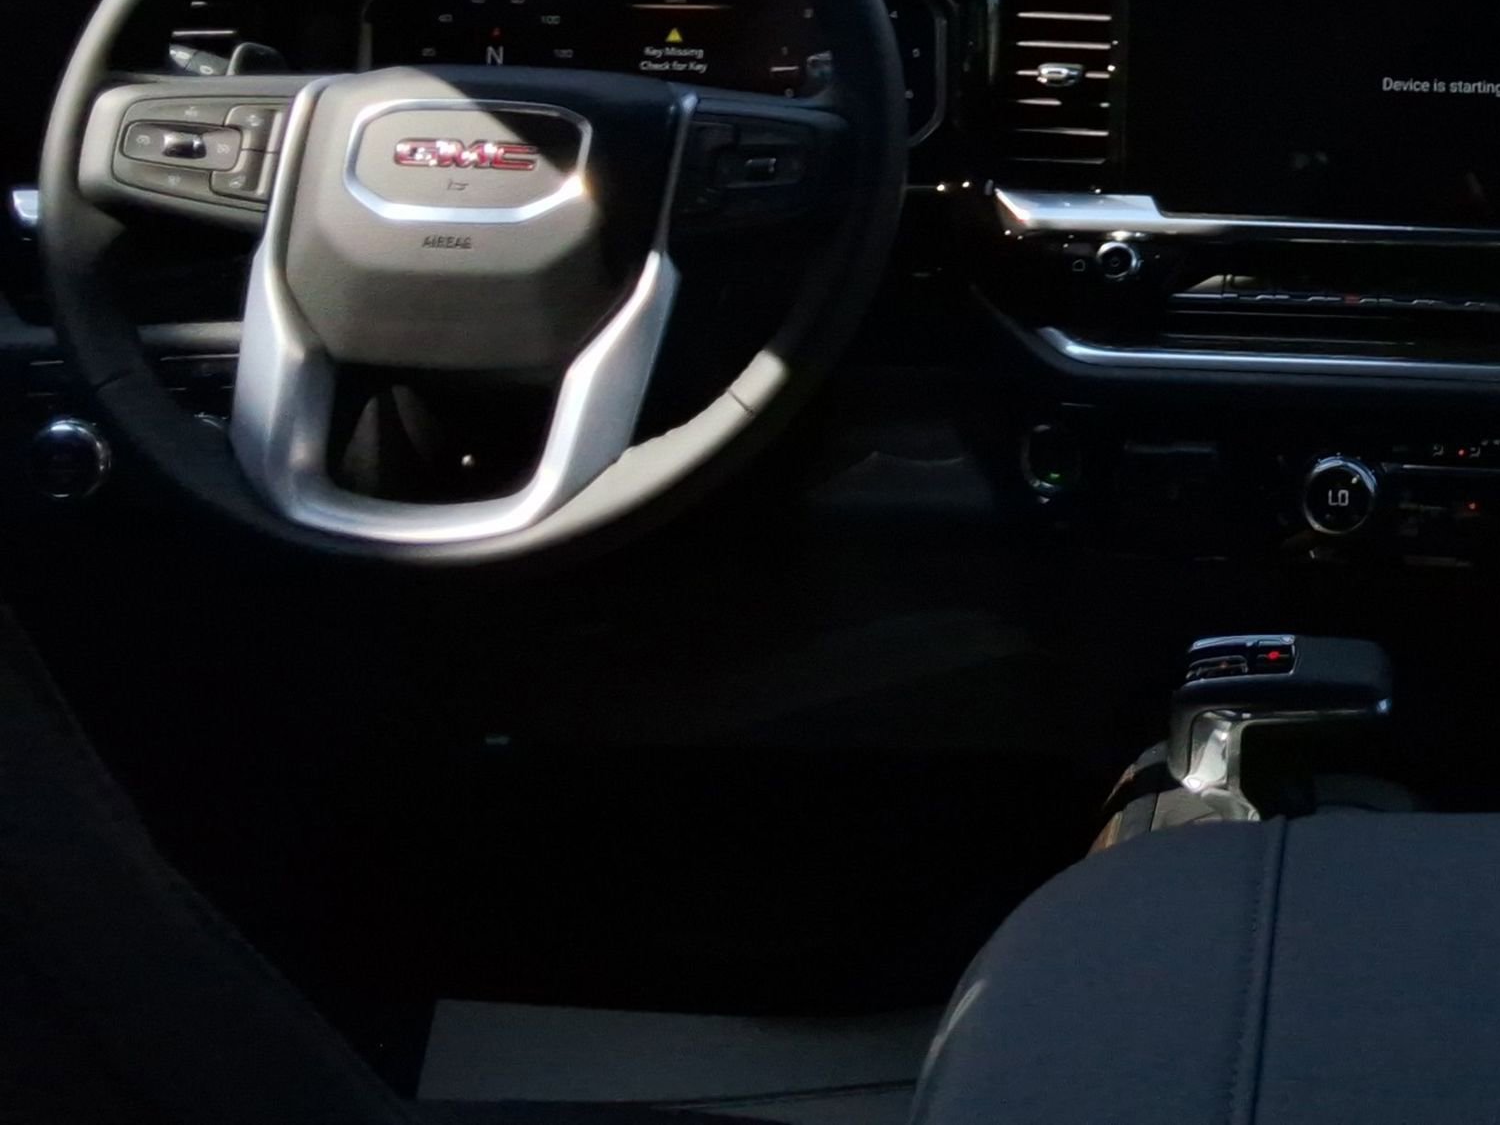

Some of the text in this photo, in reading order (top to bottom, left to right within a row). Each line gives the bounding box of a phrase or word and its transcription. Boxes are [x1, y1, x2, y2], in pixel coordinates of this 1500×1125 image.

[485, 44, 504, 66] N
[643, 46, 663, 59] Key
[639, 60, 708, 74] Check for Key
[1382, 76, 1431, 92] Device
[1433, 78, 1446, 93] is
[394, 136, 539, 172] GMC
